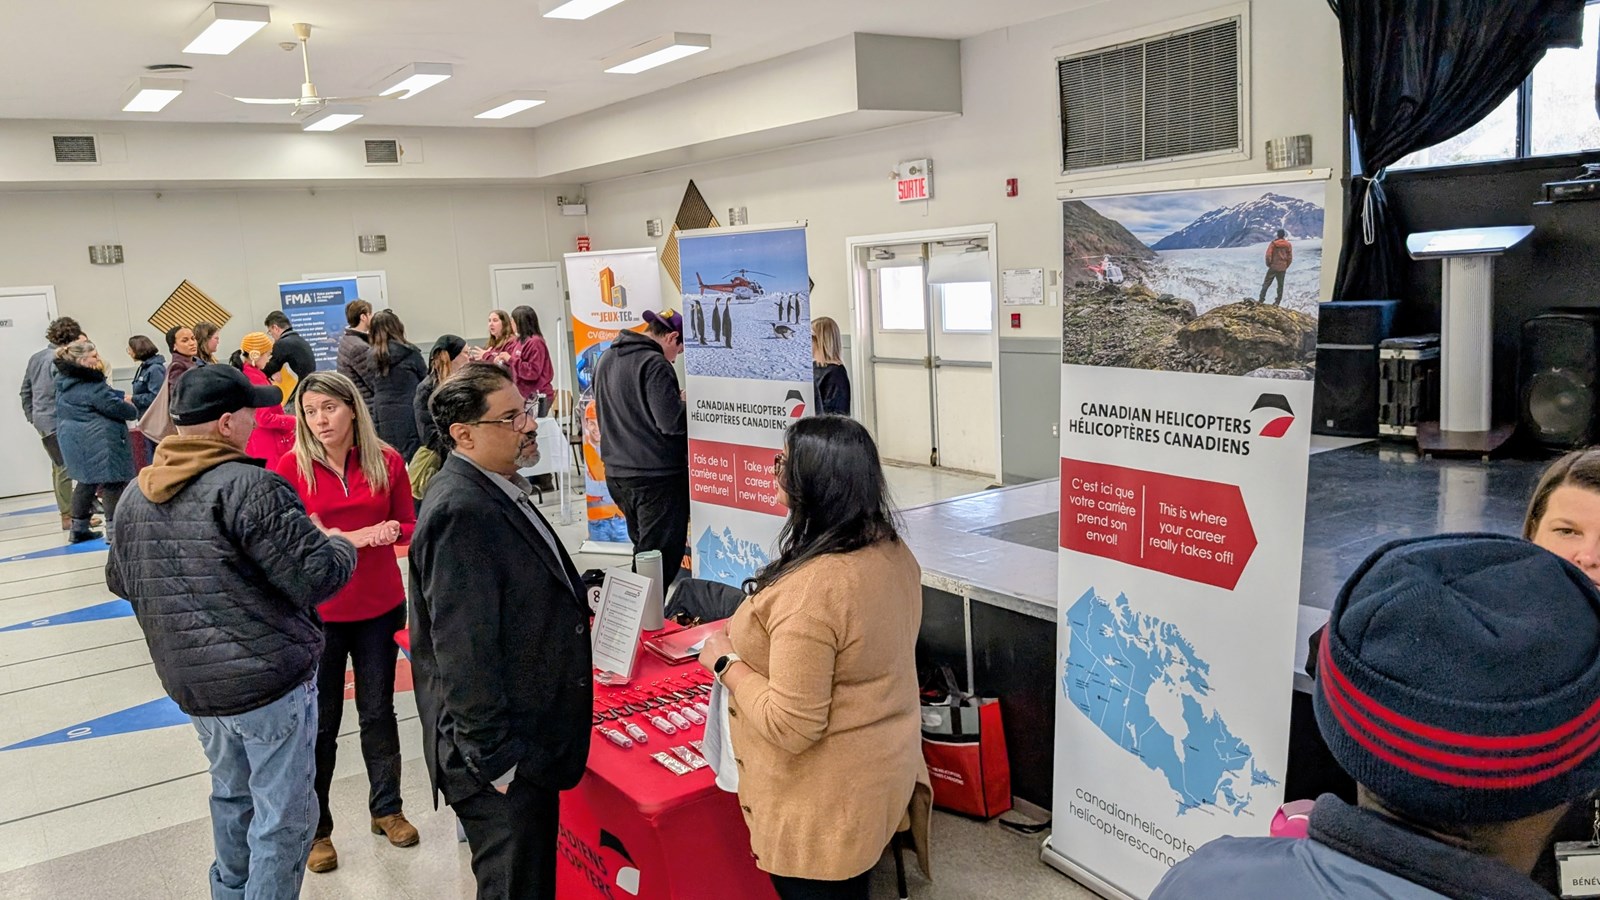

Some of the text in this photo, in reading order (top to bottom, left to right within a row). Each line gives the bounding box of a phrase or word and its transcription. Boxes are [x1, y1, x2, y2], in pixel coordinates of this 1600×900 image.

[898, 177, 926, 200] SORTIE
[285, 293, 312, 305] FMA
[696, 399, 787, 417] CANADIAN HELICOPTERS
[1081, 402, 1251, 434] CANADIAN HELICOPTERS
[691, 409, 787, 430] HÉLICOPTÈRES CANADIENS
[1069, 417, 1250, 456] HÉLICOPTÈRES CANADIENS
[693, 453, 728, 467] Fais de ta
[743, 460, 776, 475] Take yo
[691, 468, 733, 483] carrière une
[744, 477, 771, 488] career
[694, 483, 729, 496] aventure!
[739, 490, 756, 500] new
[1071, 478, 1134, 499] C'est ici que
[1069, 495, 1136, 516] votre carrière
[1159, 502, 1228, 526] This is where
[1077, 512, 1127, 531] prend son
[1086, 530, 1118, 545] envol!
[1159, 521, 1226, 544] your career
[1149, 537, 1234, 565] really takes off!
[593, 590, 601, 603] 8
[1075, 787, 1196, 857] canadianhelicopte
[1069, 801, 1176, 868] helicopterescana
